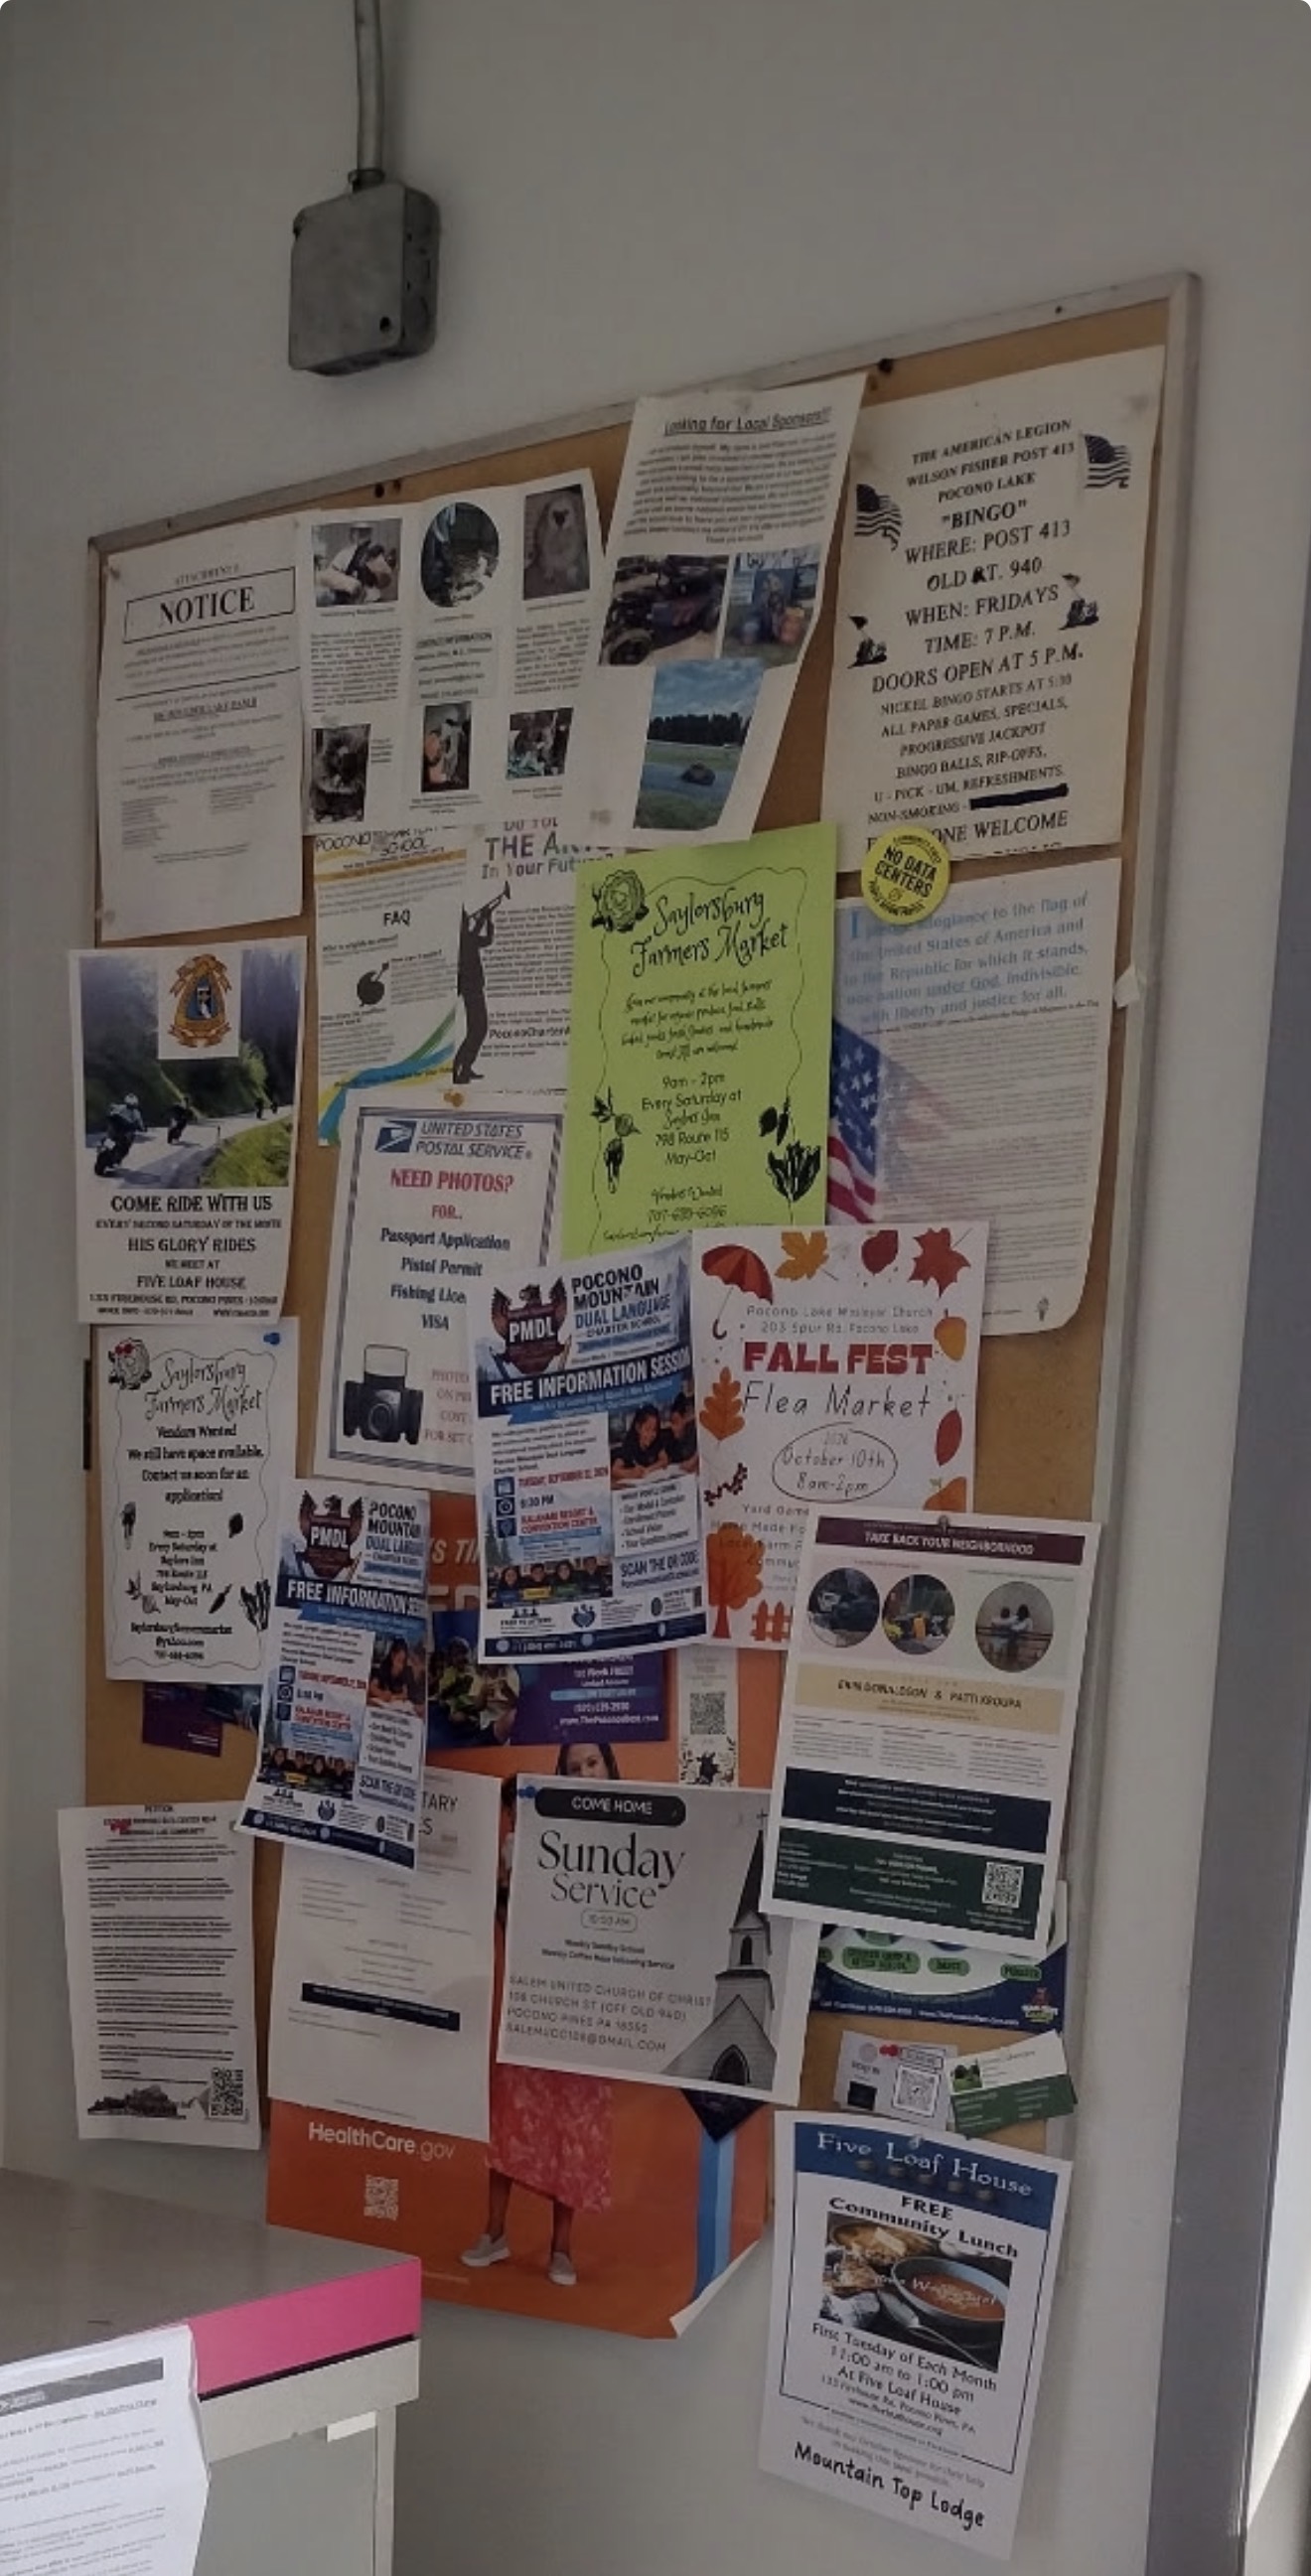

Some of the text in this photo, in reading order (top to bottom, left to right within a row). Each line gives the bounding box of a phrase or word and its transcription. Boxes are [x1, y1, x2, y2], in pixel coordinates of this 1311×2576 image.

[710, 416, 730, 432] for
[738, 416, 768, 431] Local
[913, 419, 1072, 465] THE AMERICAN LEGION
[907, 442, 1074, 487] WILSON FISHER POST 413
[939, 473, 1035, 502] POCONO LAKE
[943, 500, 1027, 529] "BINGO"
[905, 518, 1071, 564] WHERE: POST 413
[928, 570, 966, 591] OLD
[1010, 557, 1042, 576] 940
[160, 587, 254, 628] NOTICE
[906, 584, 1059, 627] WHEN: FRIDAYS
[925, 621, 1035, 653] TIME: 7 P.M.
[872, 643, 1083, 693] DOORS OPEN AT 5 P.M.
[881, 678, 1044, 715] NICKEL BINGO STARTS AT
[988, 722, 1046, 743] JACKPOT
[897, 764, 937, 779] BINGO
[973, 810, 1069, 838] WELCOME
[316, 834, 370, 852] POCONO
[485, 834, 534, 861] THE
[884, 844, 903, 865] NO
[905, 856, 937, 882] DATA
[875, 860, 933, 897] CENTERS
[383, 909, 411, 927] FAQ
[654, 887, 764, 936] Saylorsburg
[1013, 890, 1089, 917] the flag of
[631, 935, 709, 977] Farmers
[714, 918, 789, 967] Market
[928, 918, 1084, 952] States of America and
[891, 961, 949, 982] Republic
[954, 957, 972, 971] for
[978, 951, 1017, 969] which
[895, 1004, 936, 1023] liberty
[941, 999, 967, 1016] and
[972, 994, 1014, 1014] justice
[1022, 991, 1041, 1003] for
[662, 1073, 725, 1088] 9am 2pm
[642, 1090, 742, 1112] Every Saturday at
[421, 1121, 523, 1138] UNITED STATES
[656, 1134, 675, 1146] 798
[678, 1132, 711, 1145] Route
[416, 1141, 465, 1155] POSTAL
[664, 1149, 716, 1167] May-Oct
[391, 1169, 513, 1193] NEED PHOTOS?
[111, 1194, 272, 1212] COME RIDE WITH US
[128, 1236, 256, 1252] HIS GLORY RIDES
[380, 1227, 510, 1251] Passport Application
[181, 1259, 220, 1268] MEET AT
[401, 1257, 483, 1276] Pistol Permit
[137, 1275, 245, 1289] FIVE LOAF HOUSE
[571, 1264, 643, 1293] POCONO
[390, 1284, 435, 1303] Fishing
[573, 1278, 659, 1310] MOUNTAIN
[422, 1314, 449, 1330] VISA
[575, 1294, 670, 1330] DUAL LANGUAGE
[509, 1317, 555, 1343] PMDL
[744, 1342, 933, 1374] FALL FEST
[160, 1358, 246, 1392] Saylorsburg
[491, 1381, 533, 1405] FREE
[539, 1360, 648, 1398] INFORMATION
[144, 1385, 262, 1422] Farmers Market
[743, 1380, 931, 1416] Flea Market
[157, 1424, 236, 1439] Vendors Wanted
[783, 1446, 884, 1468] October 10th
[797, 1472, 868, 1498] 8am-2pm
[311, 1526, 349, 1548] PMDL
[865, 1531, 949, 1548] TAKE YOUR
[287, 1580, 324, 1601] FREE
[571, 1796, 653, 1815] COME HOME
[538, 1830, 685, 1890] Sunday
[551, 1873, 657, 1909] Service
[551, 1979, 645, 1998] UNITED CHURCH
[308, 2121, 456, 2161] HealthCare.gov
[816, 2132, 1033, 2196] Five Loaf House
[902, 2195, 953, 2220] FREE
[829, 2197, 1018, 2256] Community Lunch
[812, 2322, 997, 2392] First Tuesday of Each Month
[831, 2346, 974, 2402] 11:00 am to 1:00 pm
[838, 2366, 961, 2415] At Five Loaf House
[795, 2441, 884, 2490] Mountain
[893, 2478, 923, 2510] Top
[932, 2491, 984, 2531] Lodge
